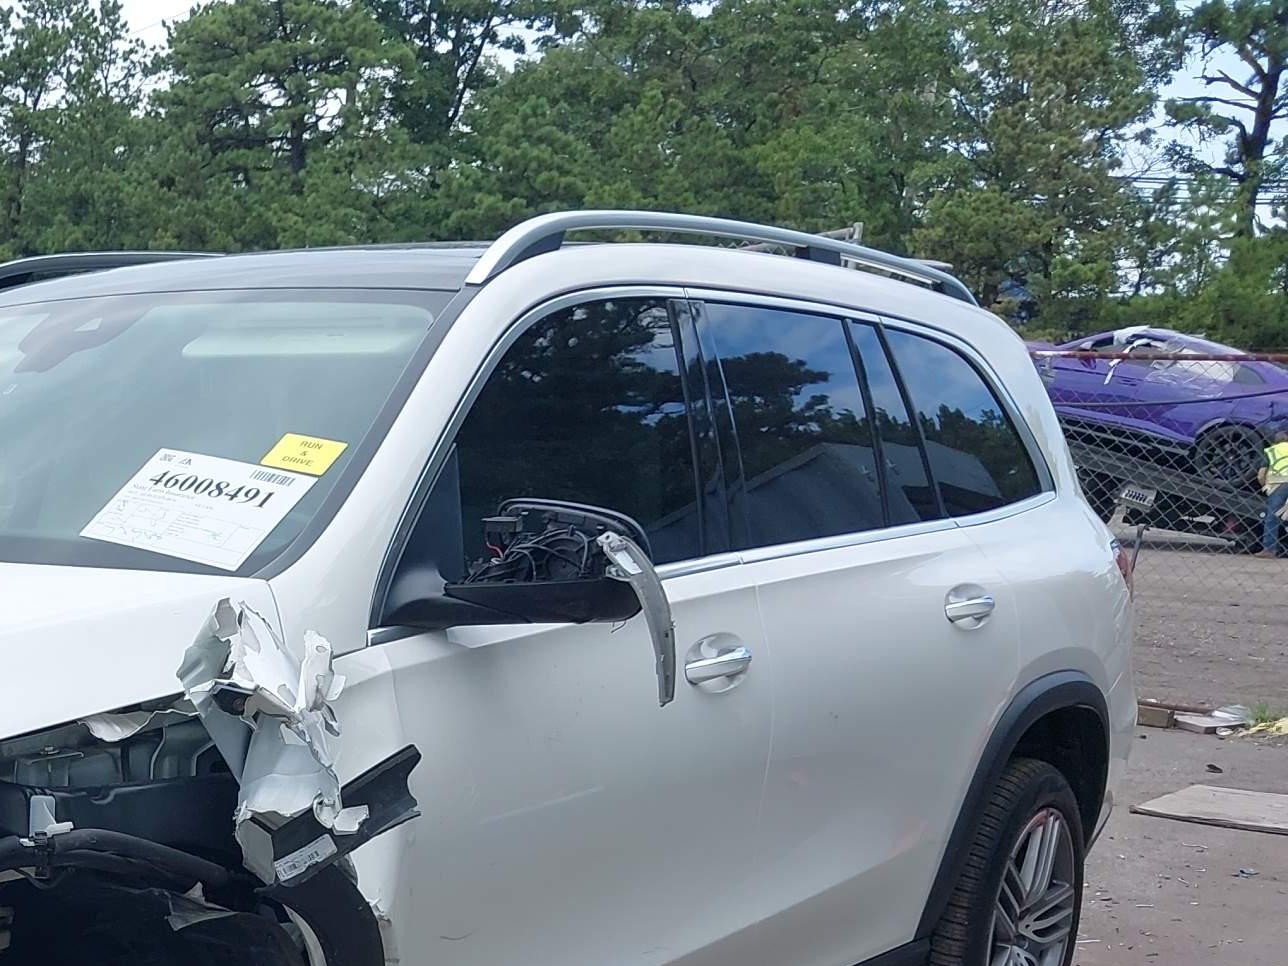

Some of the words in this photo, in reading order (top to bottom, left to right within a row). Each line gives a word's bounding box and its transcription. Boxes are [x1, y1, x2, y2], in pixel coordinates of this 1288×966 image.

[299, 440, 324, 450] RUN
[281, 455, 314, 467] DRIVE
[149, 470, 275, 508] 46008491
